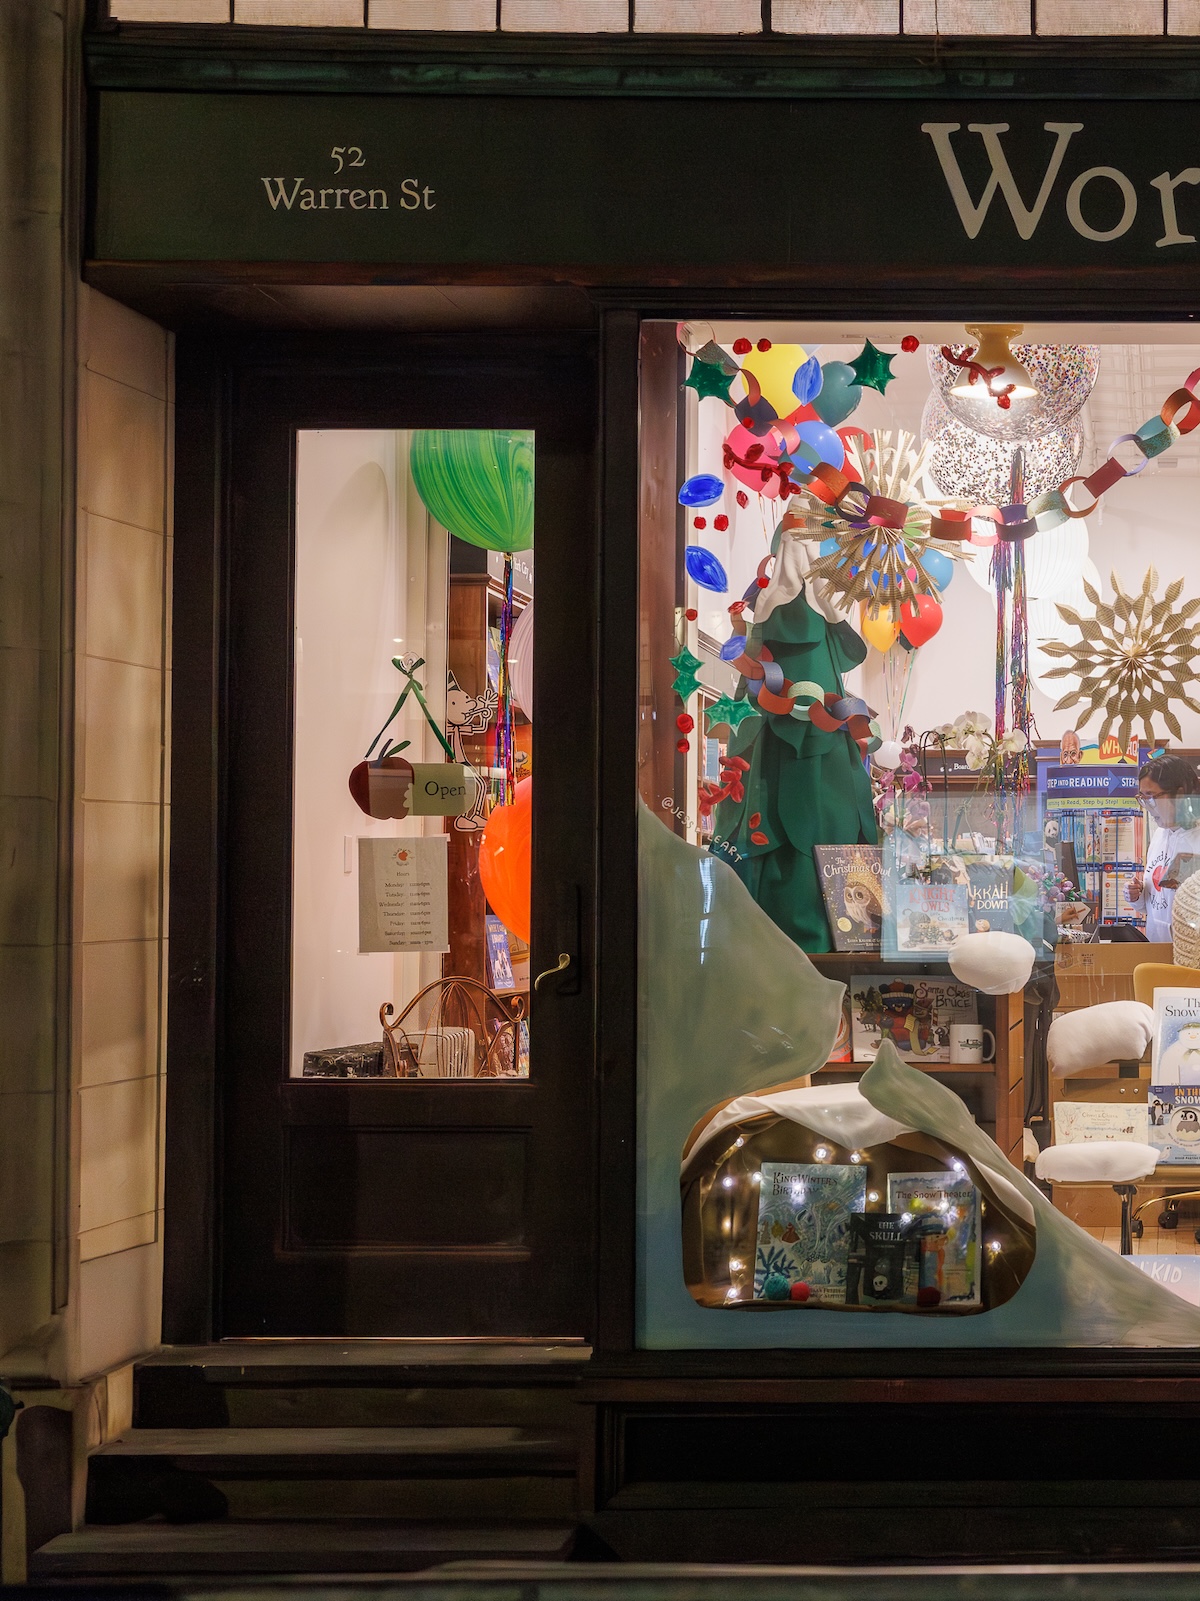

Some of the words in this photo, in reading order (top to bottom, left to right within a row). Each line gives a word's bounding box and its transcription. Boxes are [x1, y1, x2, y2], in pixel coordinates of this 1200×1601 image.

[330, 146, 366, 175] 52
[260, 177, 389, 211] Warren
[399, 178, 436, 211] St
[1047, 778, 1057, 788] STEP
[1069, 777, 1110, 787] READING
[1121, 777, 1135, 787] STEP
[424, 780, 467, 800] Open
[1082, 799, 1095, 807] Step
[1096, 799, 1104, 807] by
[835, 856, 846, 865] The
[823, 864, 870, 878] Christmas
[871, 861, 892, 877] Owl
[909, 887, 957, 904] KNIGHT
[977, 899, 1009, 910] DOWN
[914, 982, 944, 999] Santa
[1174, 1088, 1186, 1096] IN
[896, 1191, 912, 1199] The
[913, 1190, 937, 1199] Snow
[938, 1190, 973, 1199] Theater
[878, 1221, 895, 1230] THE
[869, 1231, 904, 1242] SKULL
[1150, 1261, 1183, 1284] KID
